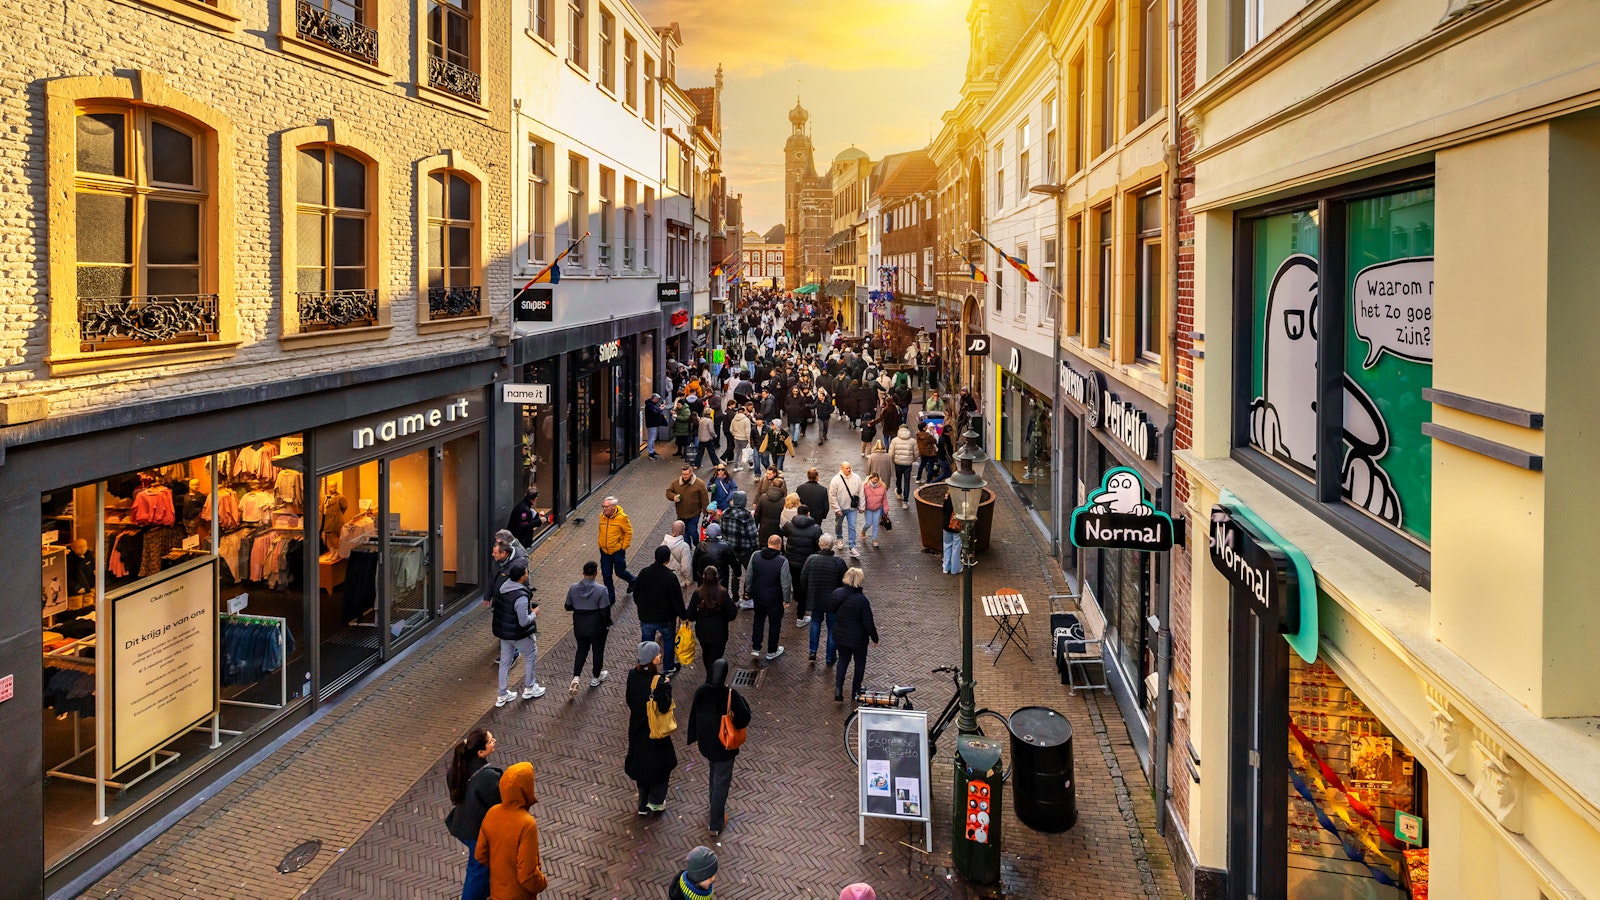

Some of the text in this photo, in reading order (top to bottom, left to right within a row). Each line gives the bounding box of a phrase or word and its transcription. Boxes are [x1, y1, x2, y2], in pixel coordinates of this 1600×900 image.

[1367, 280, 1422, 296] Waarom
[521, 299, 549, 311] snipes
[1361, 300, 1434, 322] het zo goe
[968, 339, 986, 351] JD
[1396, 326, 1431, 346] zijn?
[599, 338, 620, 363] snipes
[1009, 347, 1020, 374] JD
[507, 389, 543, 398] name it
[1060, 360, 1148, 461] Espresso Perfetto
[353, 398, 469, 449] name it
[1085, 518, 1161, 543] Normal
[1216, 521, 1270, 608] Normal
[125, 608, 206, 650] Dit krijg je van ons
[867, 732, 915, 751] Espresso
